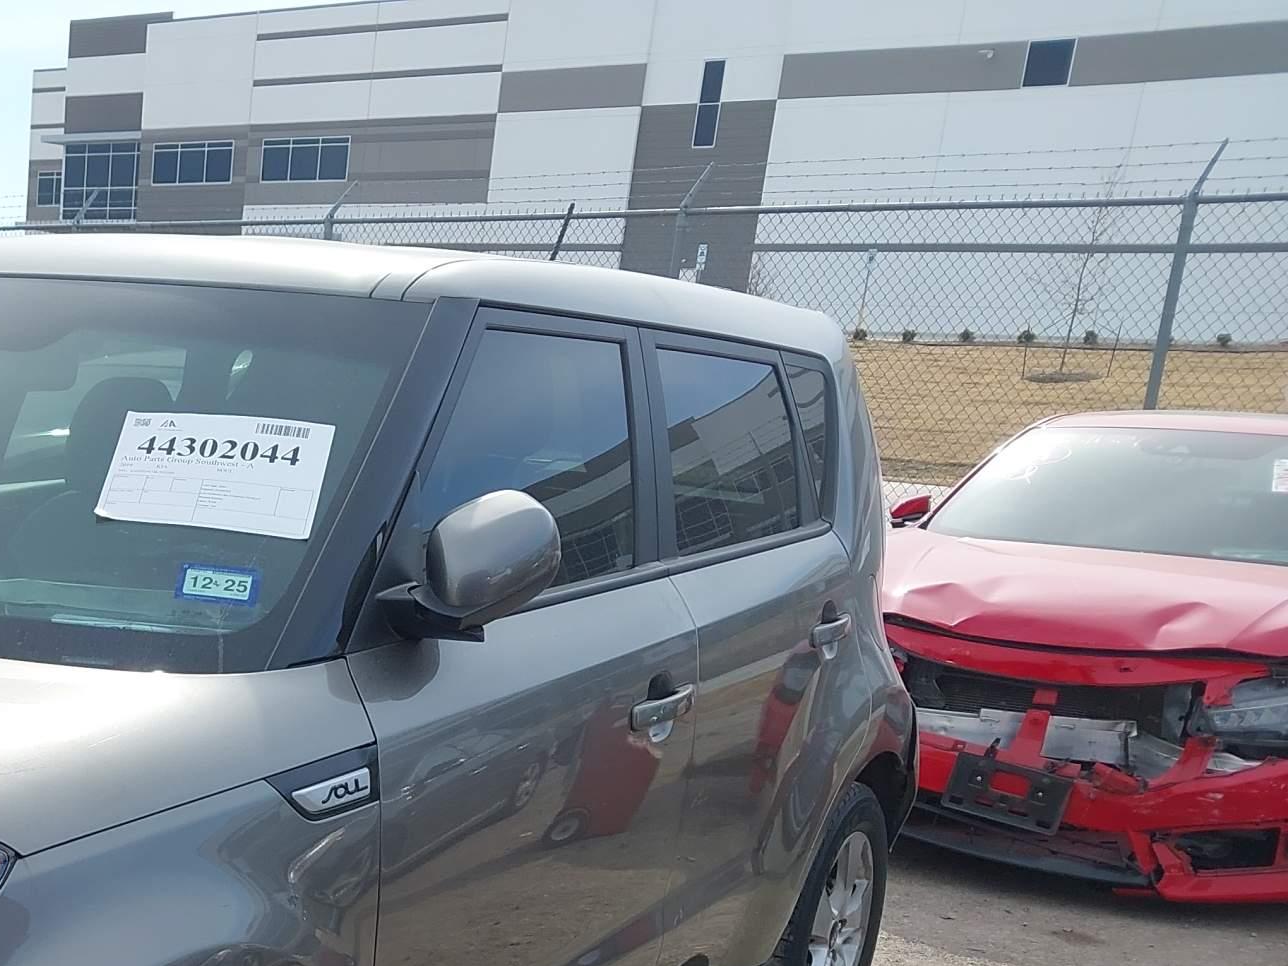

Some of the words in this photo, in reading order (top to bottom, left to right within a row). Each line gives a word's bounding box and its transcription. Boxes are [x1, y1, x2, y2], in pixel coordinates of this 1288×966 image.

[137, 435, 300, 466] 44302044
[191, 575, 213, 590] 12
[223, 578, 249, 593] 25
